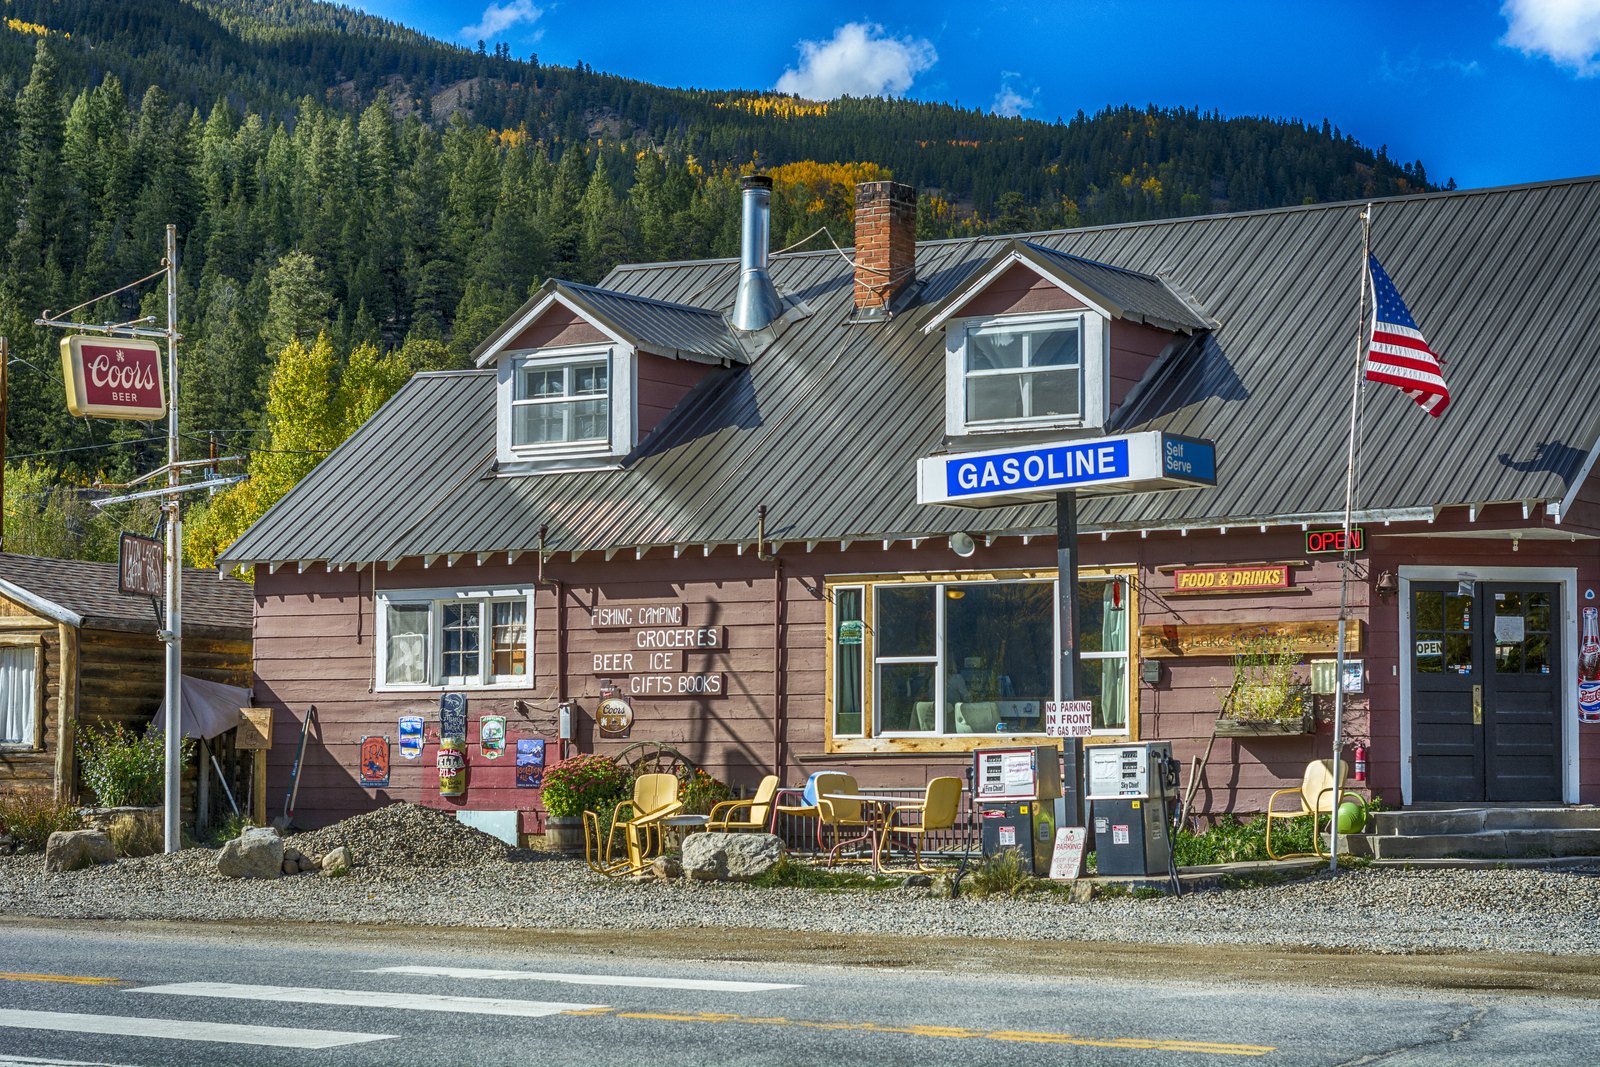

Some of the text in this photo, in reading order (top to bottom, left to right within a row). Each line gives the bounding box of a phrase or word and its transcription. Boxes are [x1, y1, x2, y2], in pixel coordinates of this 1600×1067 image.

[88, 354, 155, 390] Coors
[112, 392, 138, 402] BEER
[1166, 441, 1184, 457] Self
[958, 446, 1116, 490] GASOLINE
[1166, 456, 1192, 473] Serve
[1309, 531, 1360, 551] OPEN
[1181, 569, 1280, 587] FOOD & DRINKS
[591, 606, 681, 625] FISHING CAMPING
[1416, 643, 1442, 653] OPEN
[593, 653, 674, 671] BEER ICE
[631, 676, 720, 693] GIFTS BOOKS
[603, 704, 625, 715] Coors
[1047, 702, 1091, 712] NO PARKING
[1047, 714, 1091, 724] IN FRONT
[1047, 726, 1092, 736] OF GAS PUMPS
[437, 756, 465, 767] ELLA
